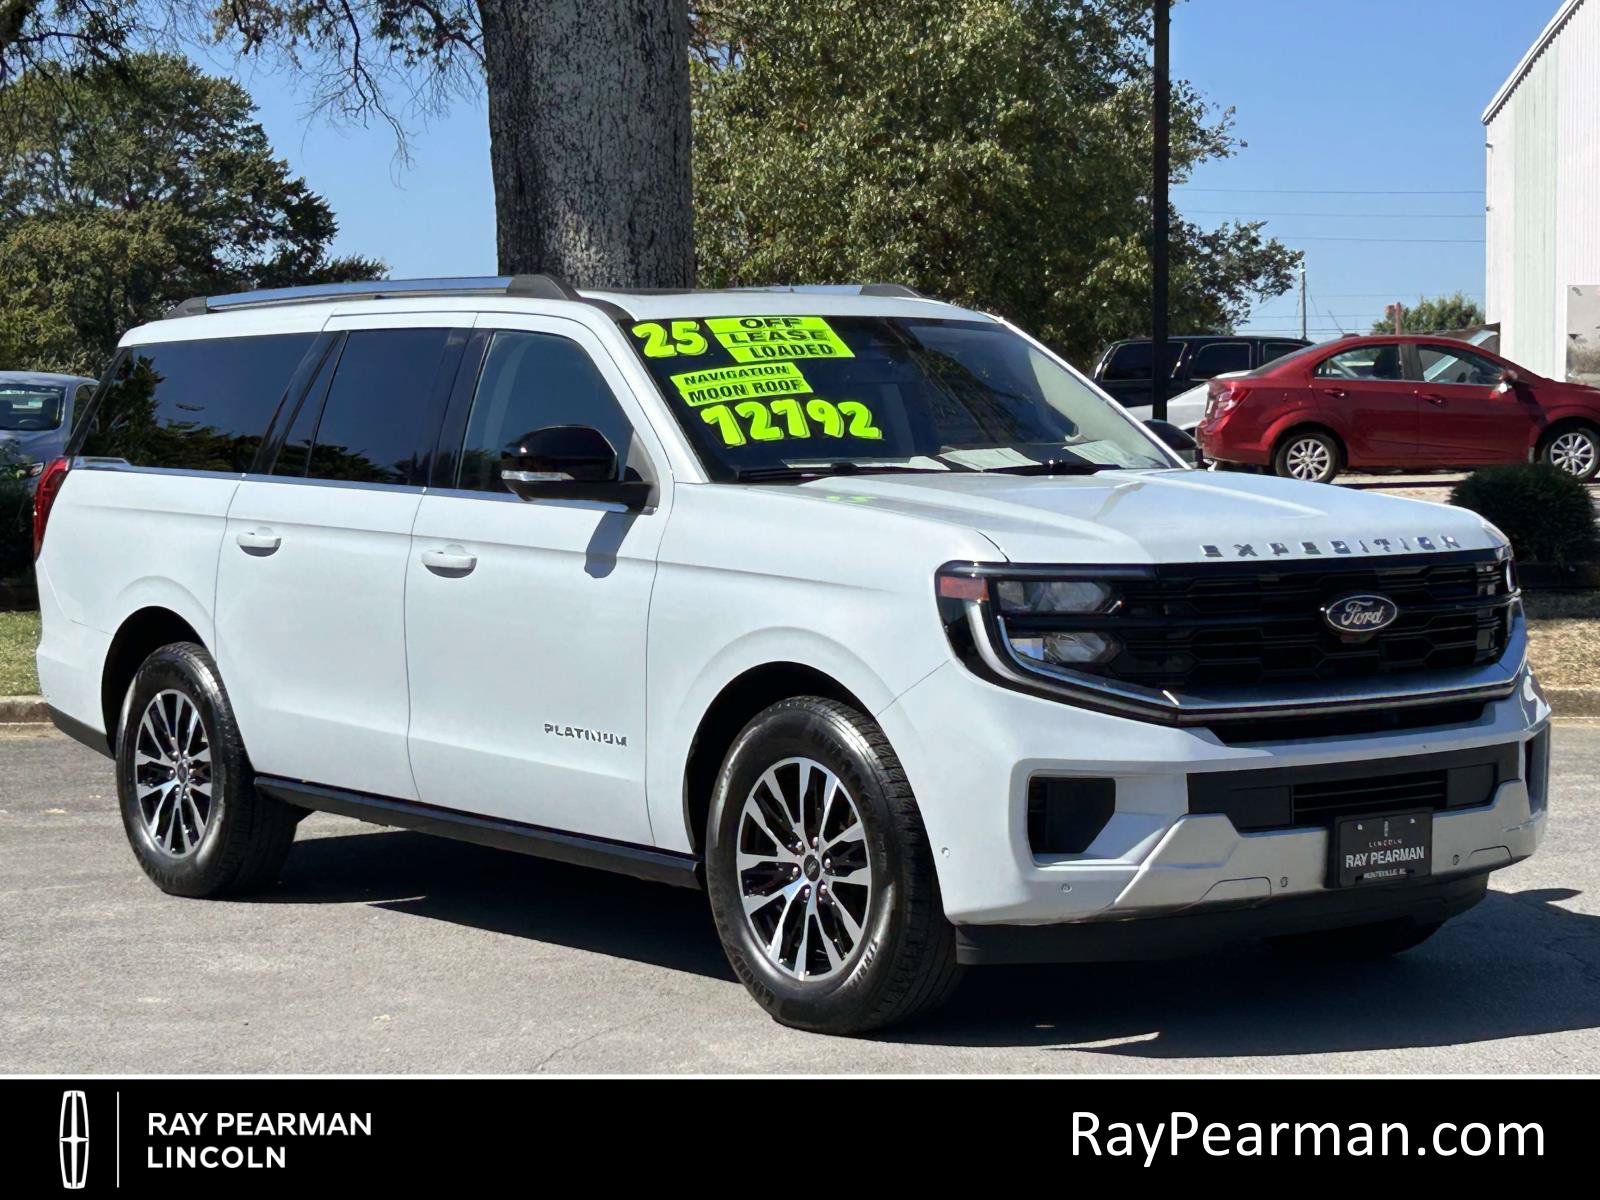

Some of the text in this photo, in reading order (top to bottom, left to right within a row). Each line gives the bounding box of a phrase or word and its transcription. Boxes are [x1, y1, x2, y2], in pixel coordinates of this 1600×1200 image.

[739, 317, 802, 330] OFF
[632, 320, 709, 358] 25
[730, 329, 828, 344] LEASE
[750, 343, 836, 359] LOADED
[683, 365, 790, 386] NAVIGATION
[688, 379, 804, 404] MOON ROOF
[700, 399, 883, 447] 72792
[1200, 534, 1461, 559] EXPEDITION
[1341, 600, 1385, 626] Ford
[544, 723, 628, 747] PLATINUM
[1346, 846, 1424, 868] RAY PEARMAN
